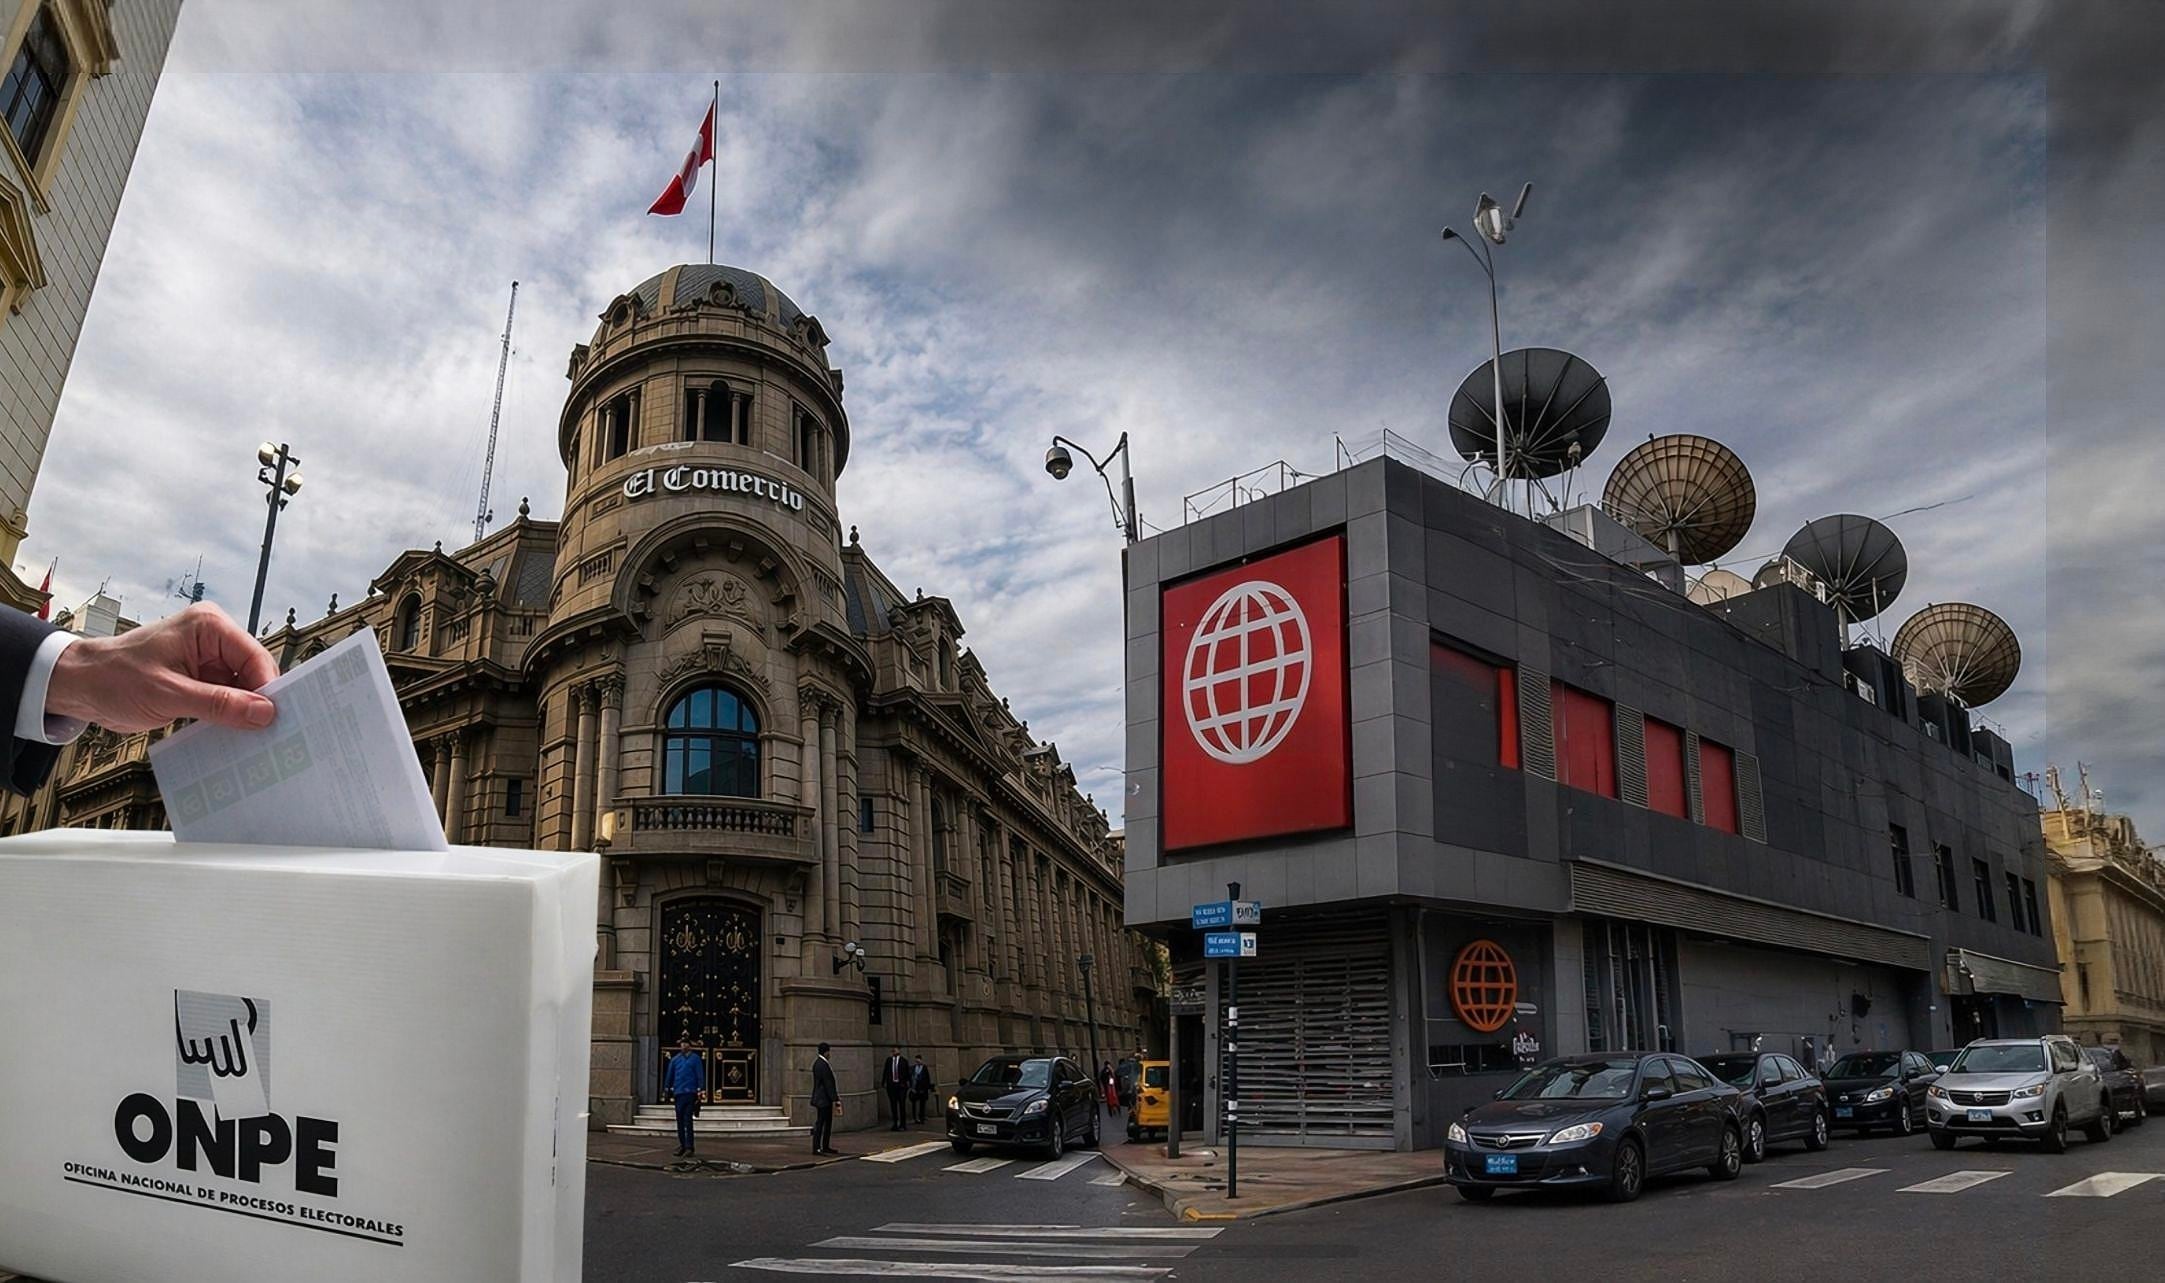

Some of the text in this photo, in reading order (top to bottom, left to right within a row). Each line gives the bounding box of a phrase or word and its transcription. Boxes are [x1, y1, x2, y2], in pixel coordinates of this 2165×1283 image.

[623, 464, 804, 511] El Comercio
[114, 1092, 339, 1198] ONPE
[63, 1161, 404, 1237] OFICINA NACIONAL DE PROCESOS ELECTORALES
